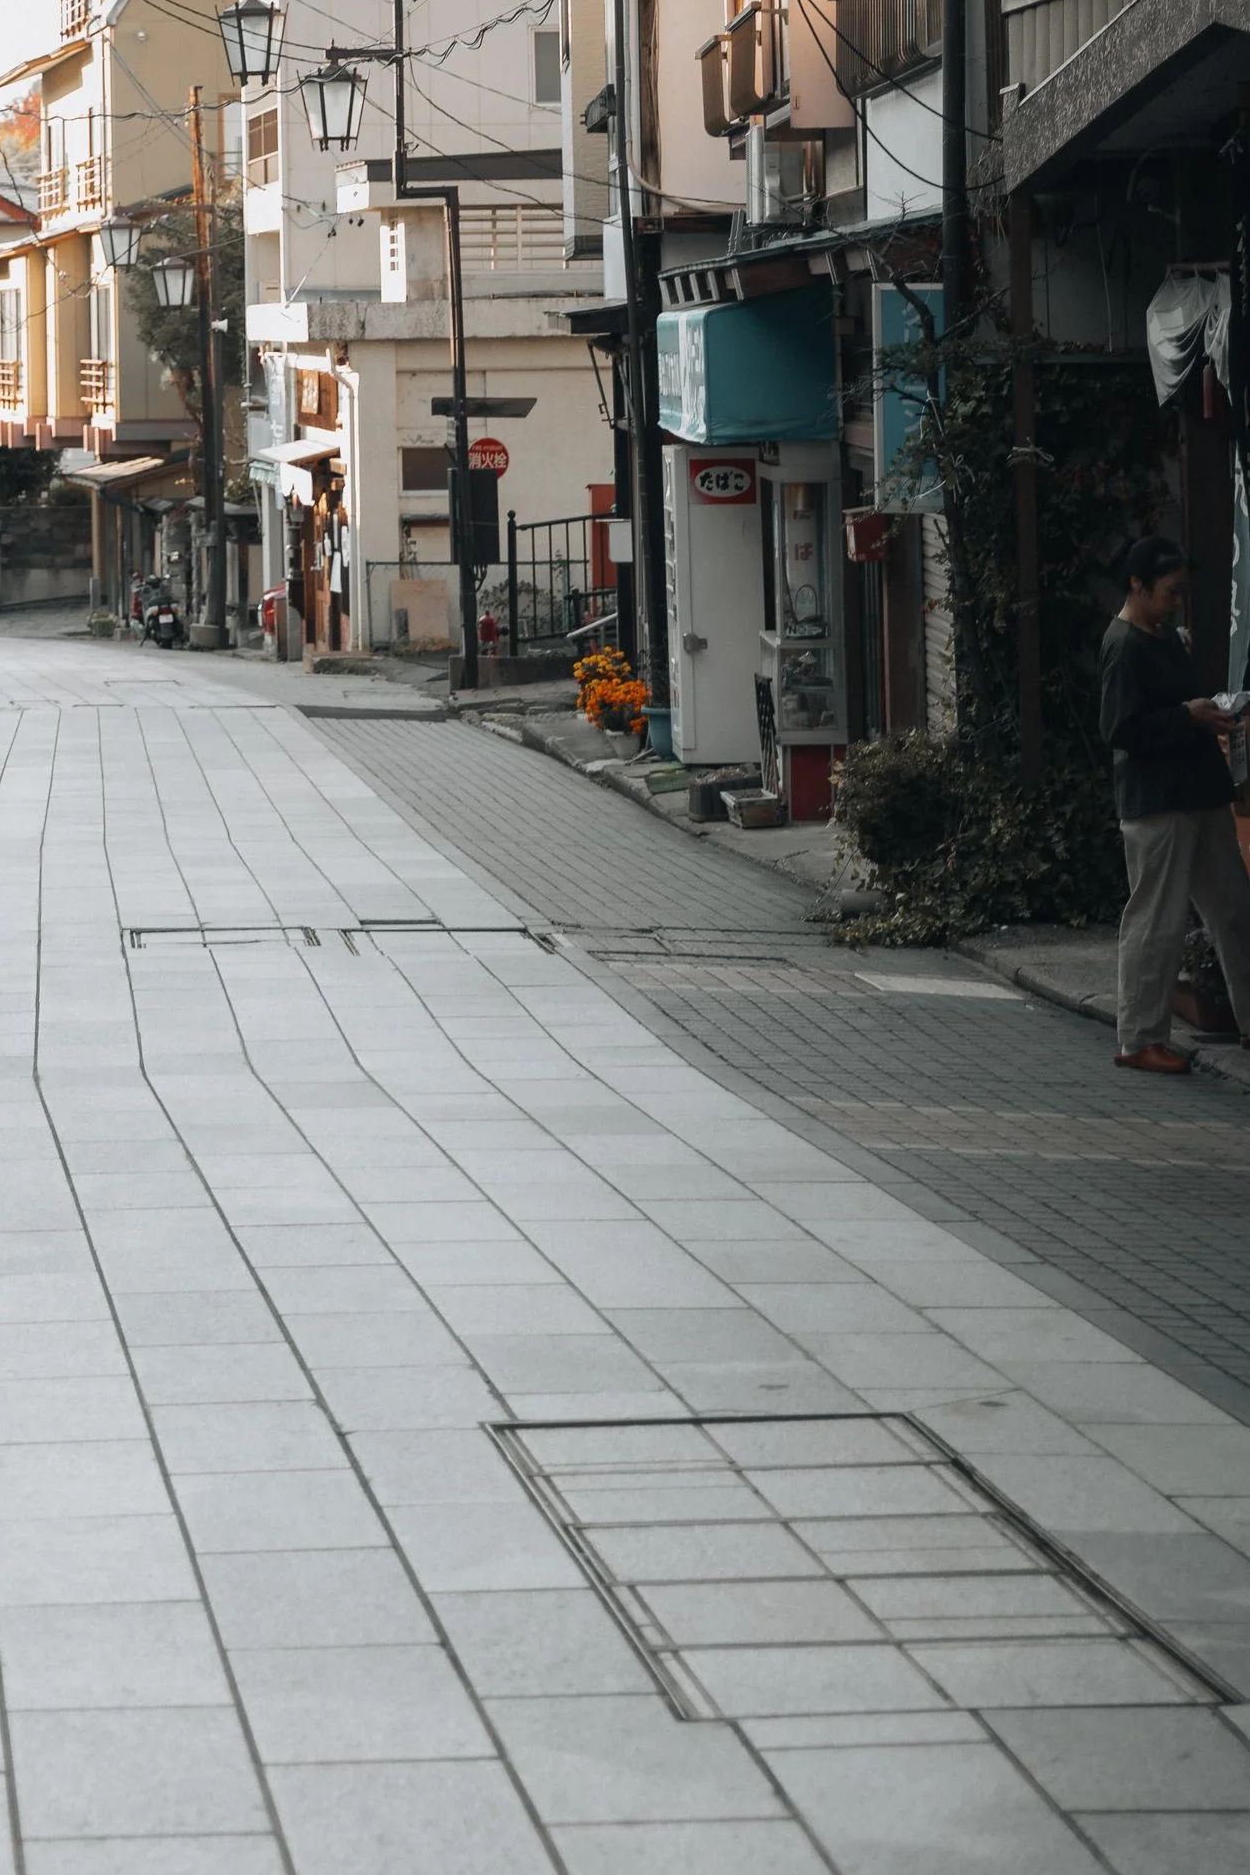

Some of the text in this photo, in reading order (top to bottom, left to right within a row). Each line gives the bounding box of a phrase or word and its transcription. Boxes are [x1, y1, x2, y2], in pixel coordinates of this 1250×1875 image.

[468, 452, 507, 469] 消火栓
[699, 470, 745, 492] たばこ
